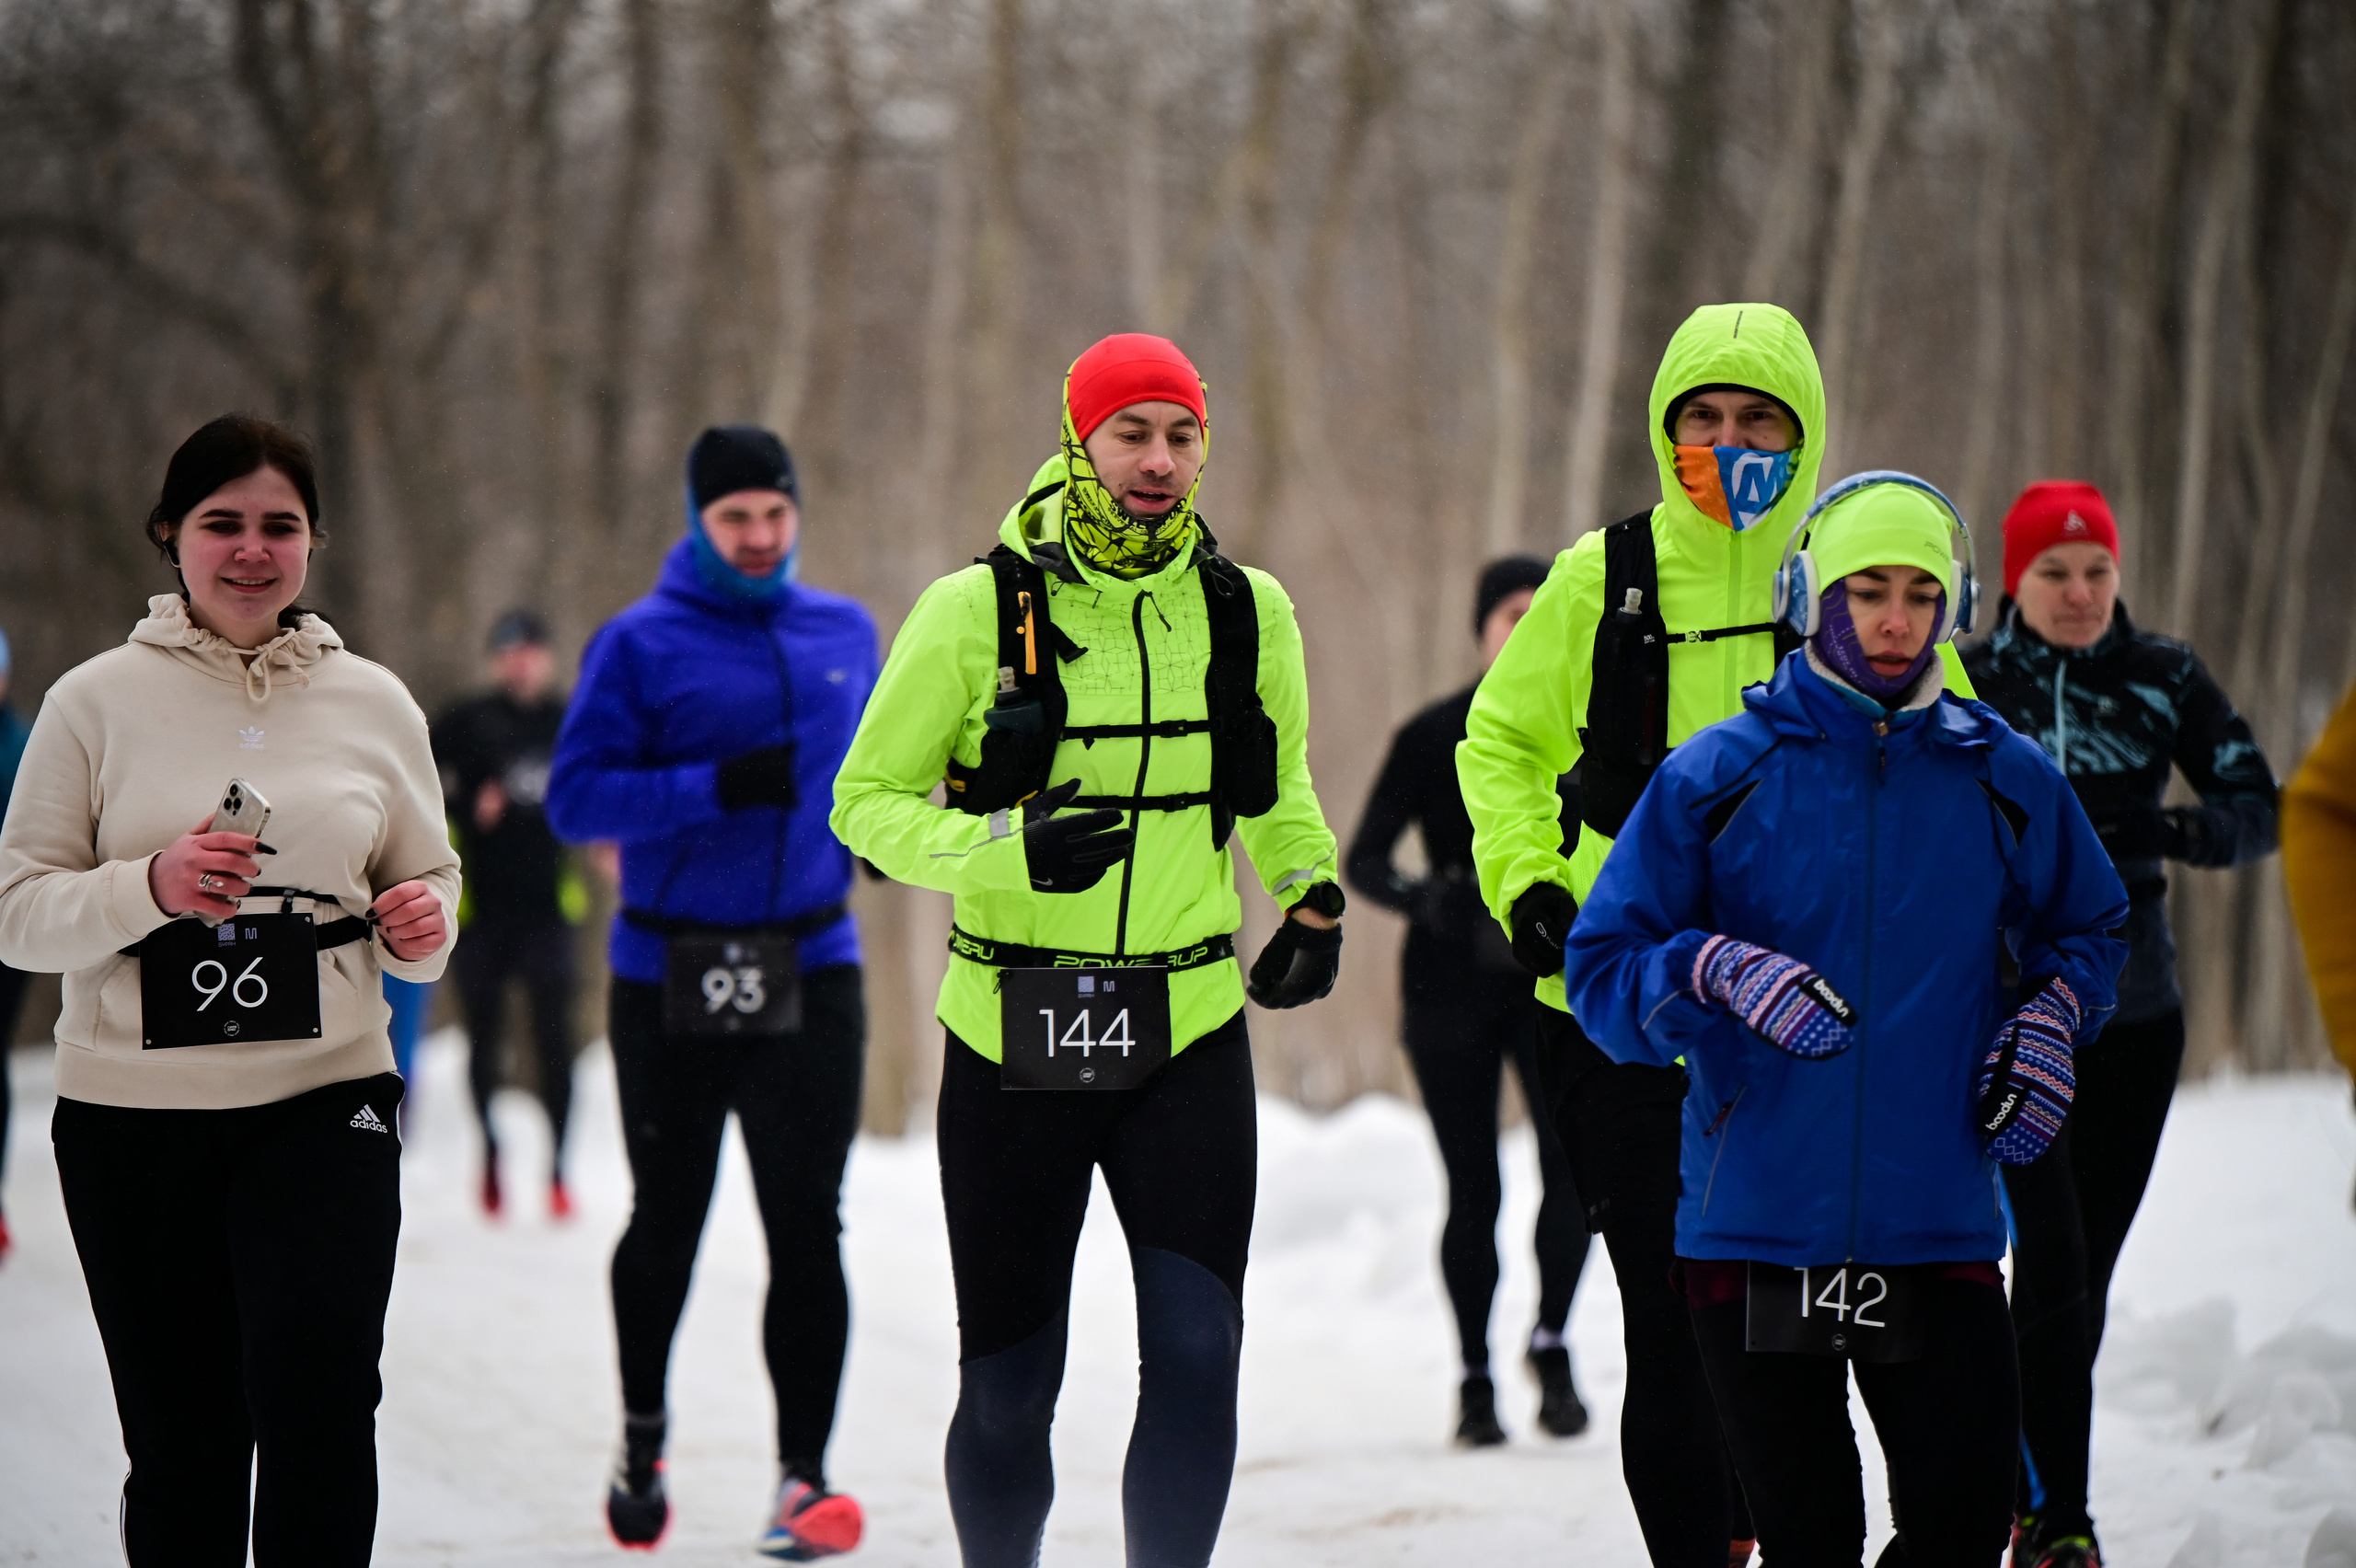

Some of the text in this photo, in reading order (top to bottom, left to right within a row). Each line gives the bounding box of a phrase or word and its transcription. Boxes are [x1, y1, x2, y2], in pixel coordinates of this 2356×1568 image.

[191, 956, 269, 1012] 96
[700, 966, 767, 1014] 93
[1038, 1008, 1137, 1057] 144
[350, 1119, 387, 1133] adidas
[1793, 1266, 1888, 1328] 142
